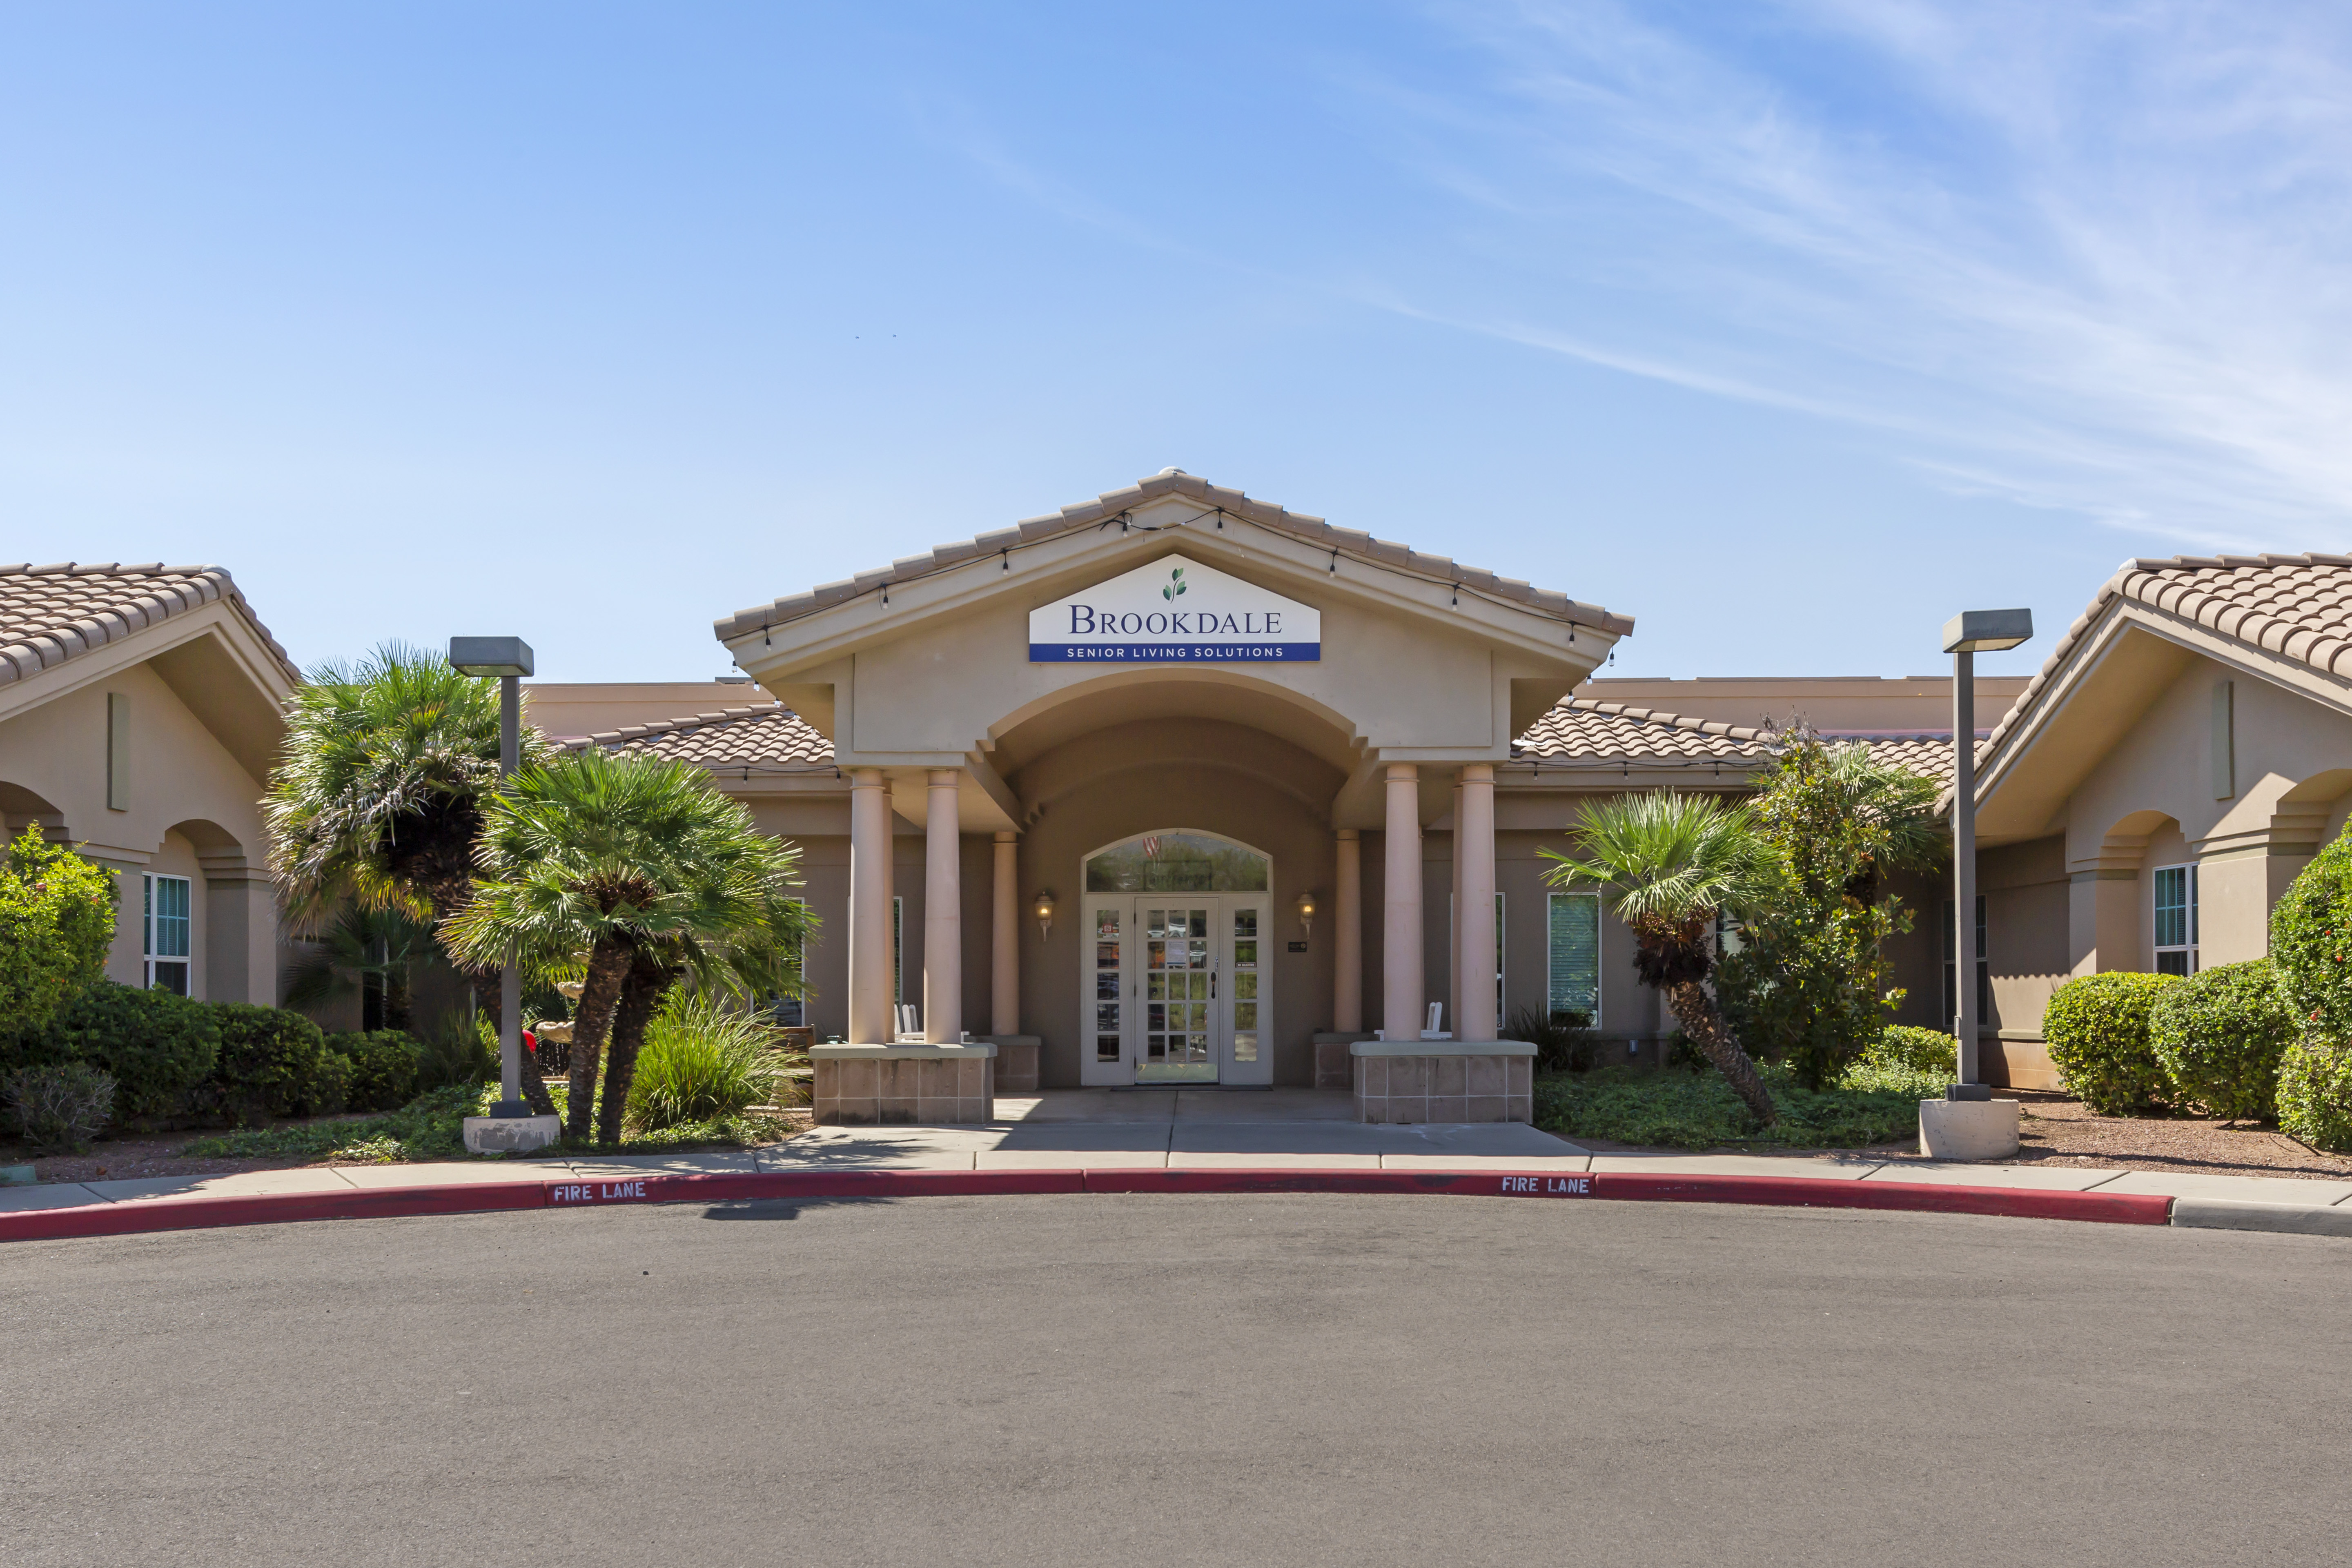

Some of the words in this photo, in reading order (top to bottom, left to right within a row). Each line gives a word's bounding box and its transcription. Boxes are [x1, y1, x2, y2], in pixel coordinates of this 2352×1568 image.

[1067, 605, 1282, 634] BROOKDALE
[1067, 648, 1124, 657] SENIOR
[1134, 648, 1186, 657] LIVING
[1195, 648, 1283, 657] SOLUTIONS
[555, 1185, 592, 1201] FIRE
[602, 1182, 646, 1198] LANE
[1502, 1177, 1539, 1192] FIRE
[1548, 1178, 1589, 1193] LANE
